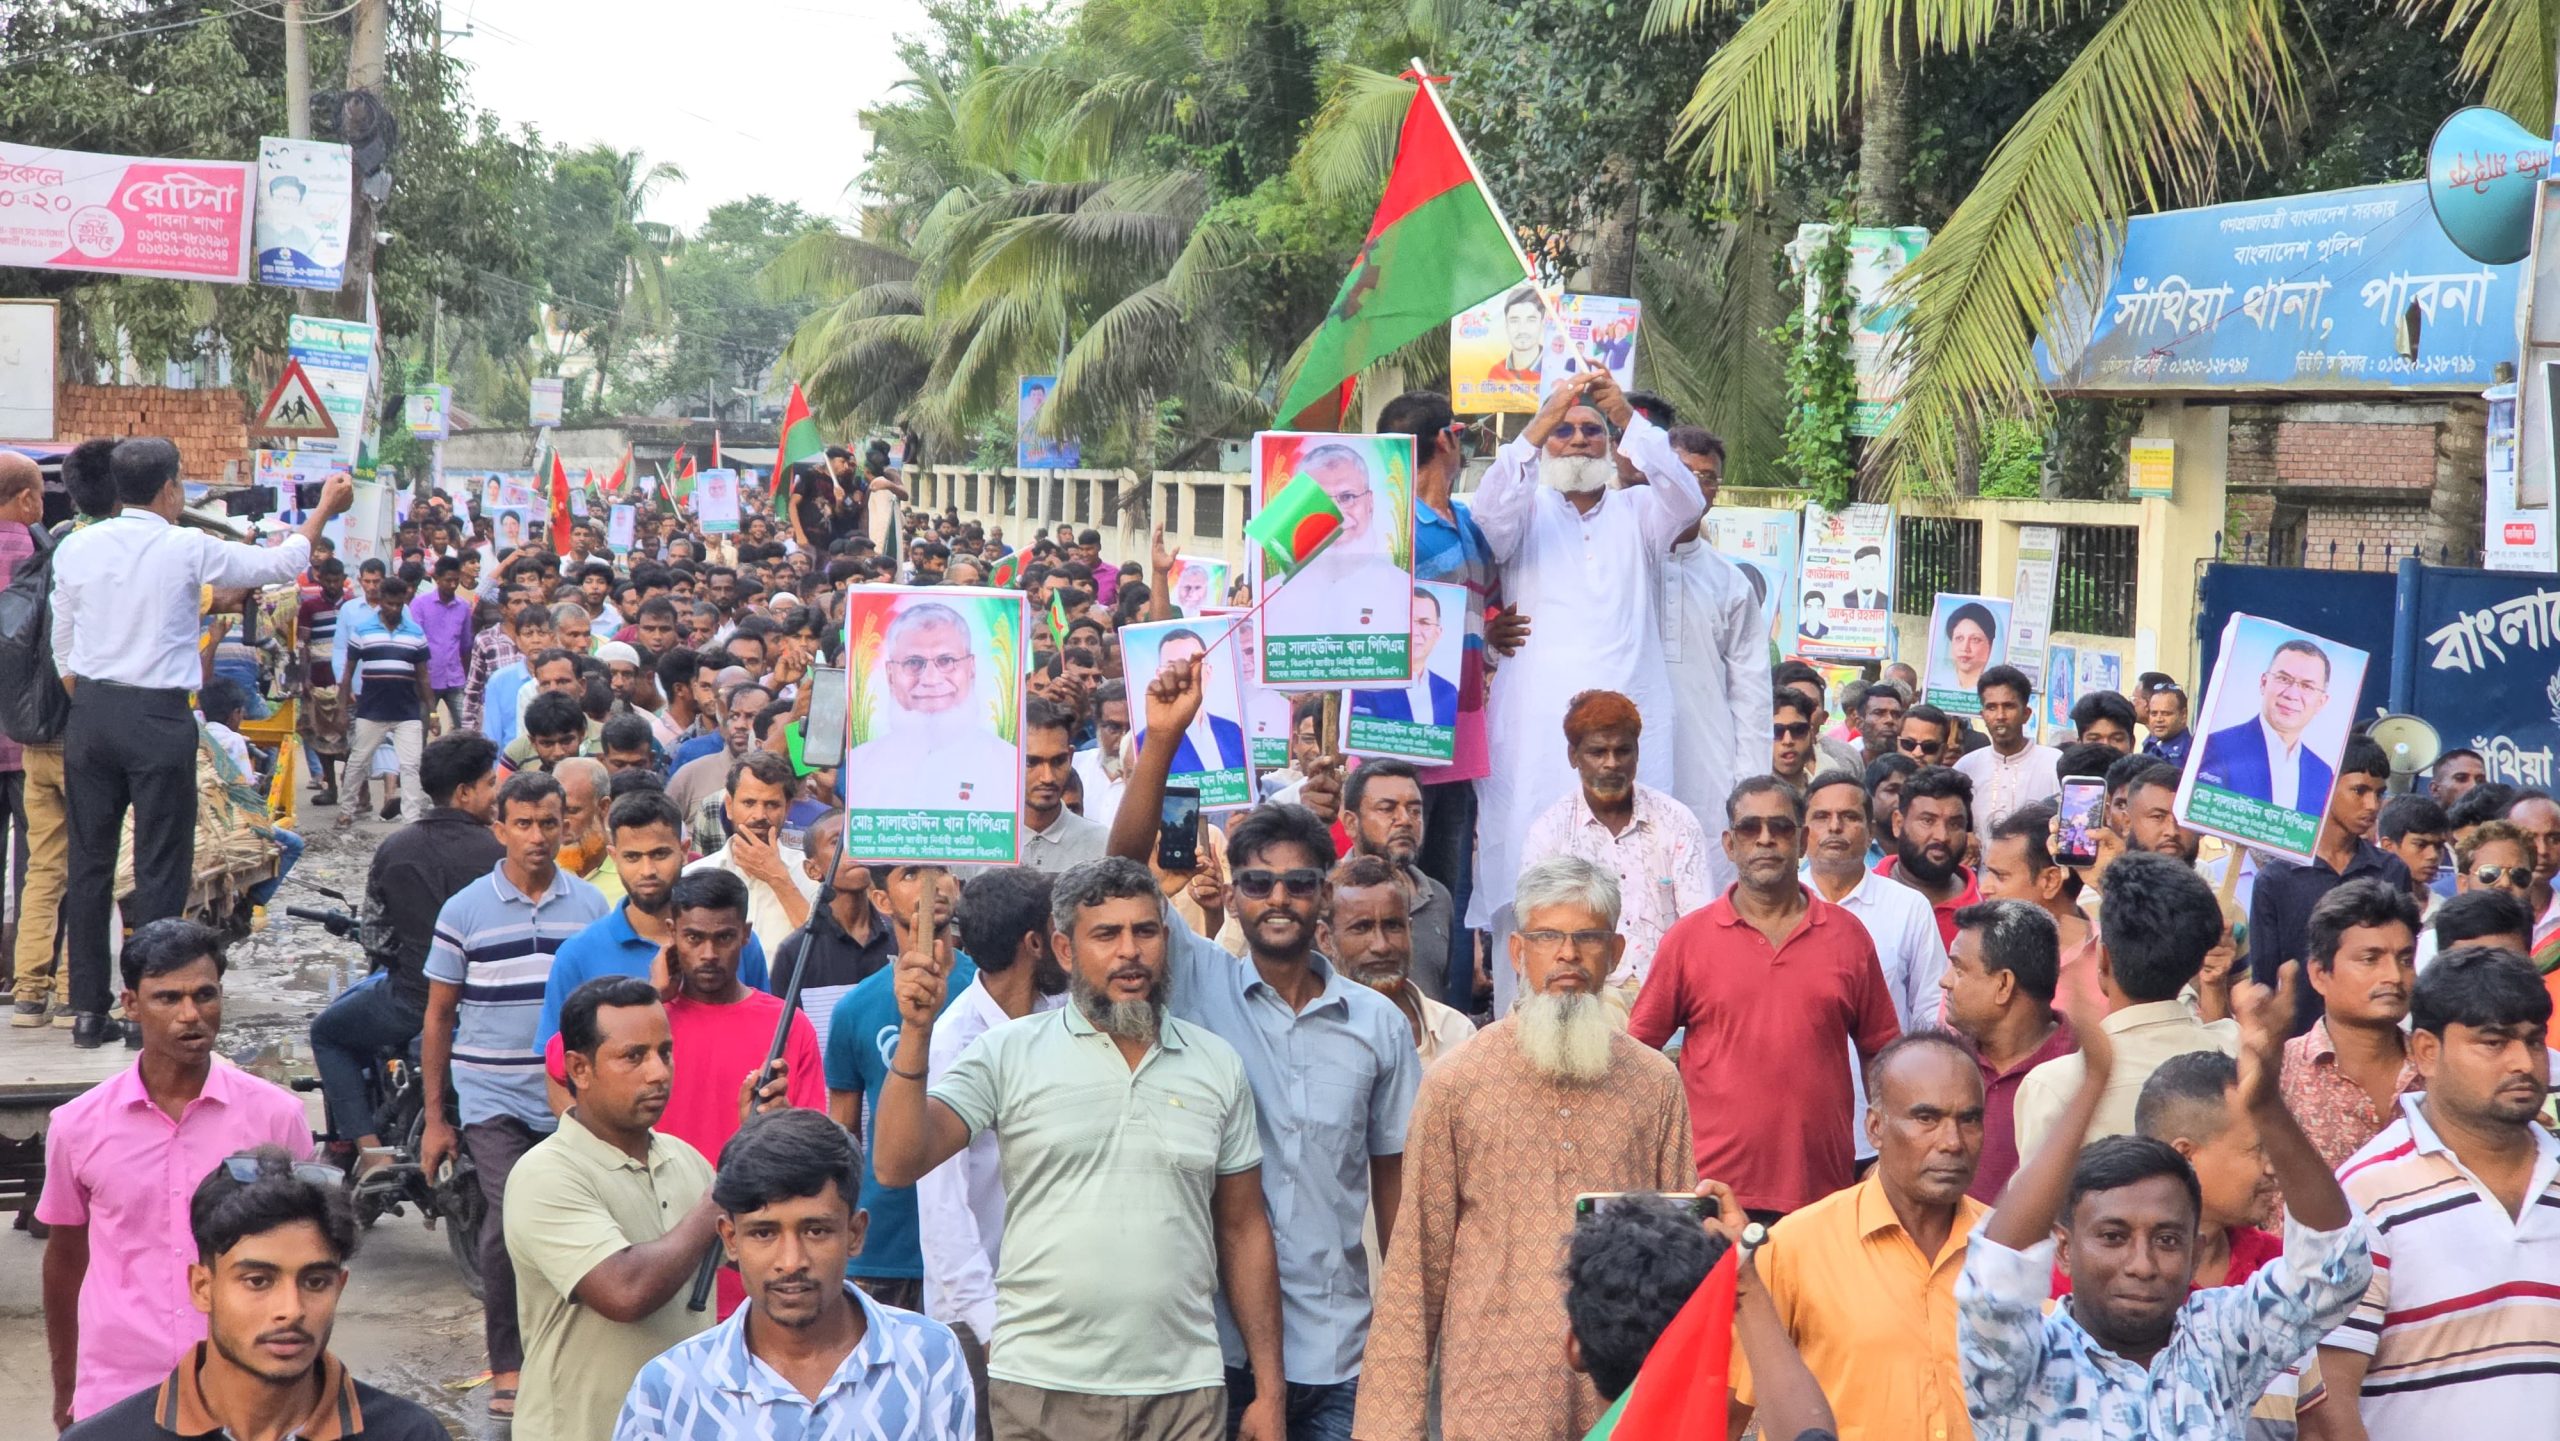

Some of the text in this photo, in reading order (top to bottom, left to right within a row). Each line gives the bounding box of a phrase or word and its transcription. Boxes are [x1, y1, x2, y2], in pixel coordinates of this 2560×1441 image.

[122, 171, 239, 213] রেটিনা
[145, 212, 225, 233] পাবনা শাখা
[2290, 203, 2349, 228] বাংলাদেশ
[2352, 199, 2400, 220] সরকার
[2234, 231, 2367, 266] বাংলাদেশ পুলিশ
[2114, 265, 2498, 340] সাঁথিয়া থানা, পাবনা
[1828, 607, 1885, 624] আব্দুর রহমান
[1266, 635, 1406, 656] মোঃ সালাহউদ্দিন খান পিপিএম
[2471, 735, 2553, 788] াঁথিয়া
[1216, 771, 1245, 786] পিপিএম
[850, 811, 1012, 834] মোঃ সালাহউদ্দিন খান পিপিএম
